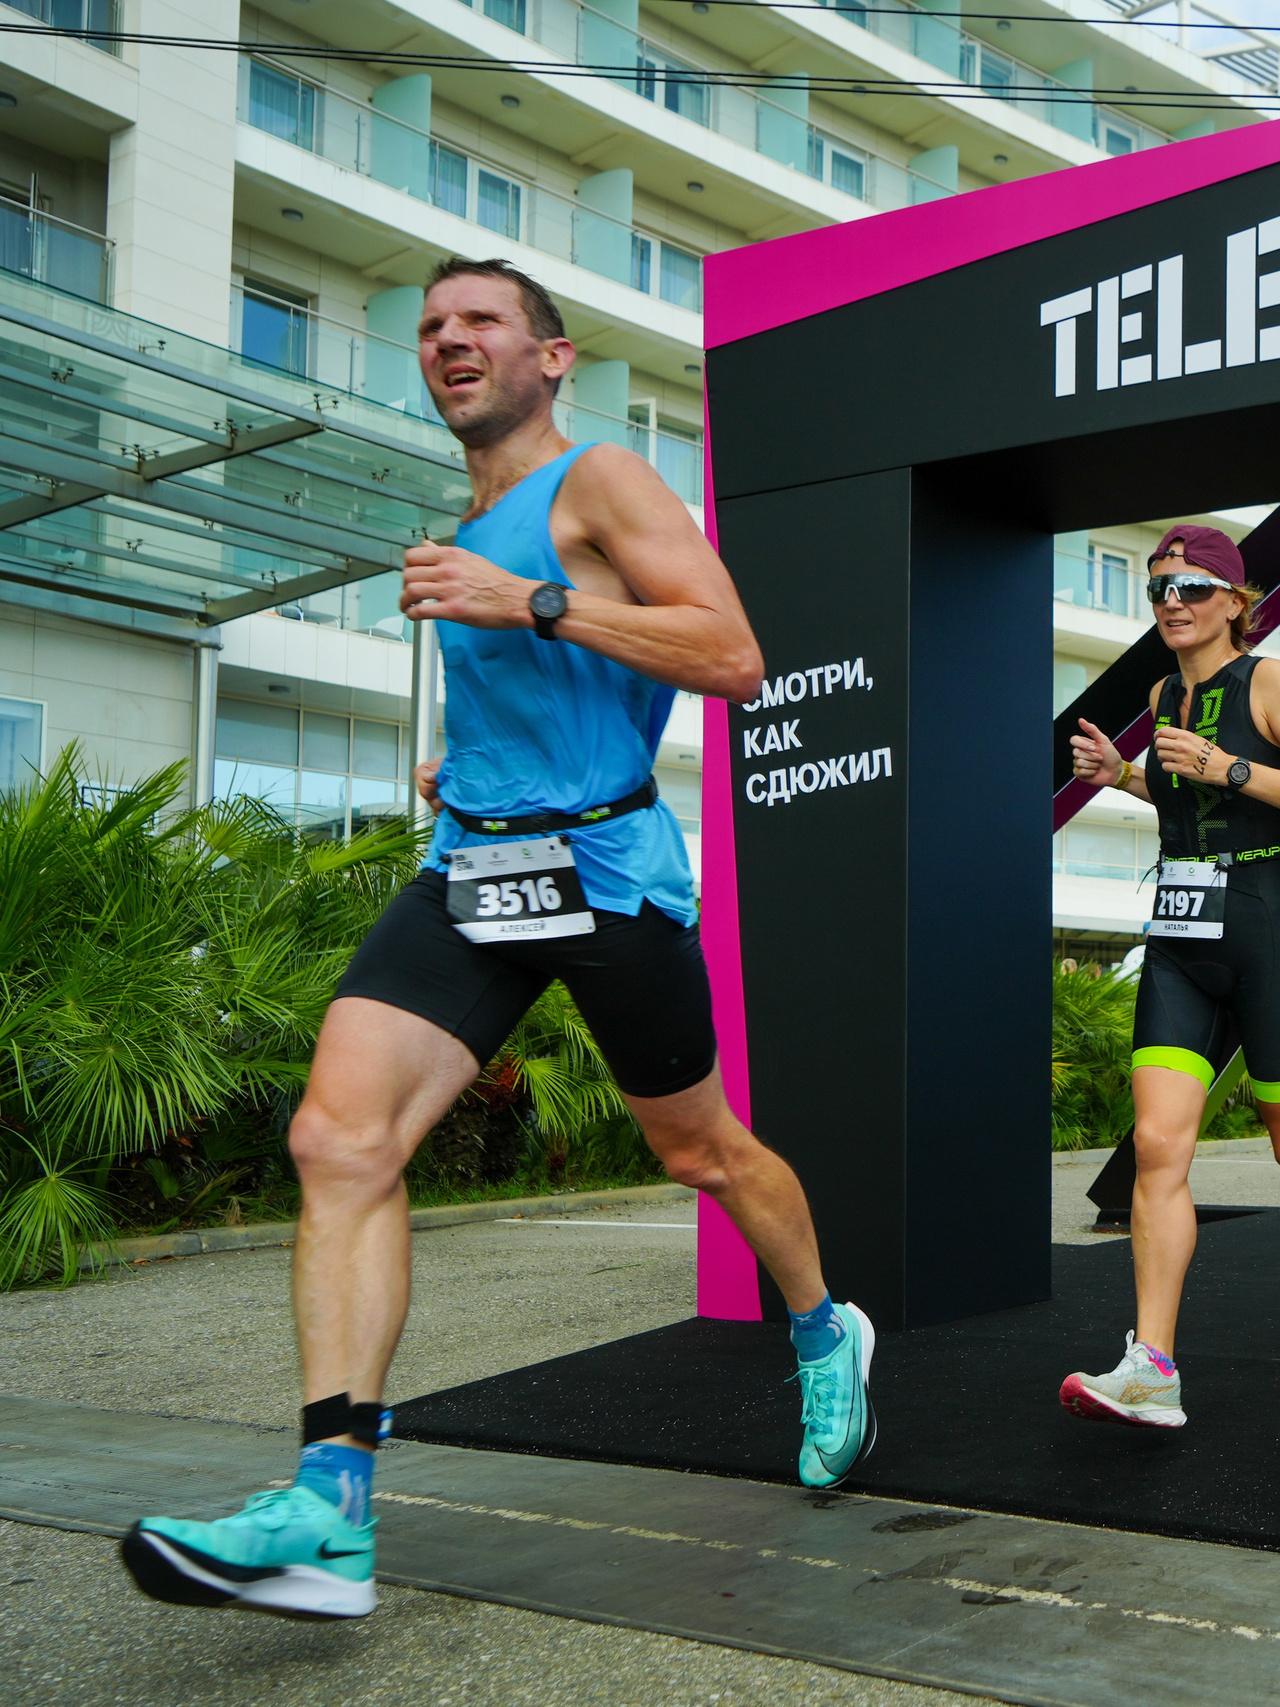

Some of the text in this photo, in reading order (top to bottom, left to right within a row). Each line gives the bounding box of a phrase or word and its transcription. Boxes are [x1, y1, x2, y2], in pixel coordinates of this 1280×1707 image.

[743, 719, 803, 759] КАК
[1193, 742, 1215, 776] 2197
[746, 747, 893, 807] СДЮЖИЛ
[476, 876, 562, 917] 3516
[1157, 890, 1205, 917] 2197
[500, 920, 547, 933] АЛЕКСЕЙ
[1164, 923, 1188, 932] НАТАЛЬЯ
